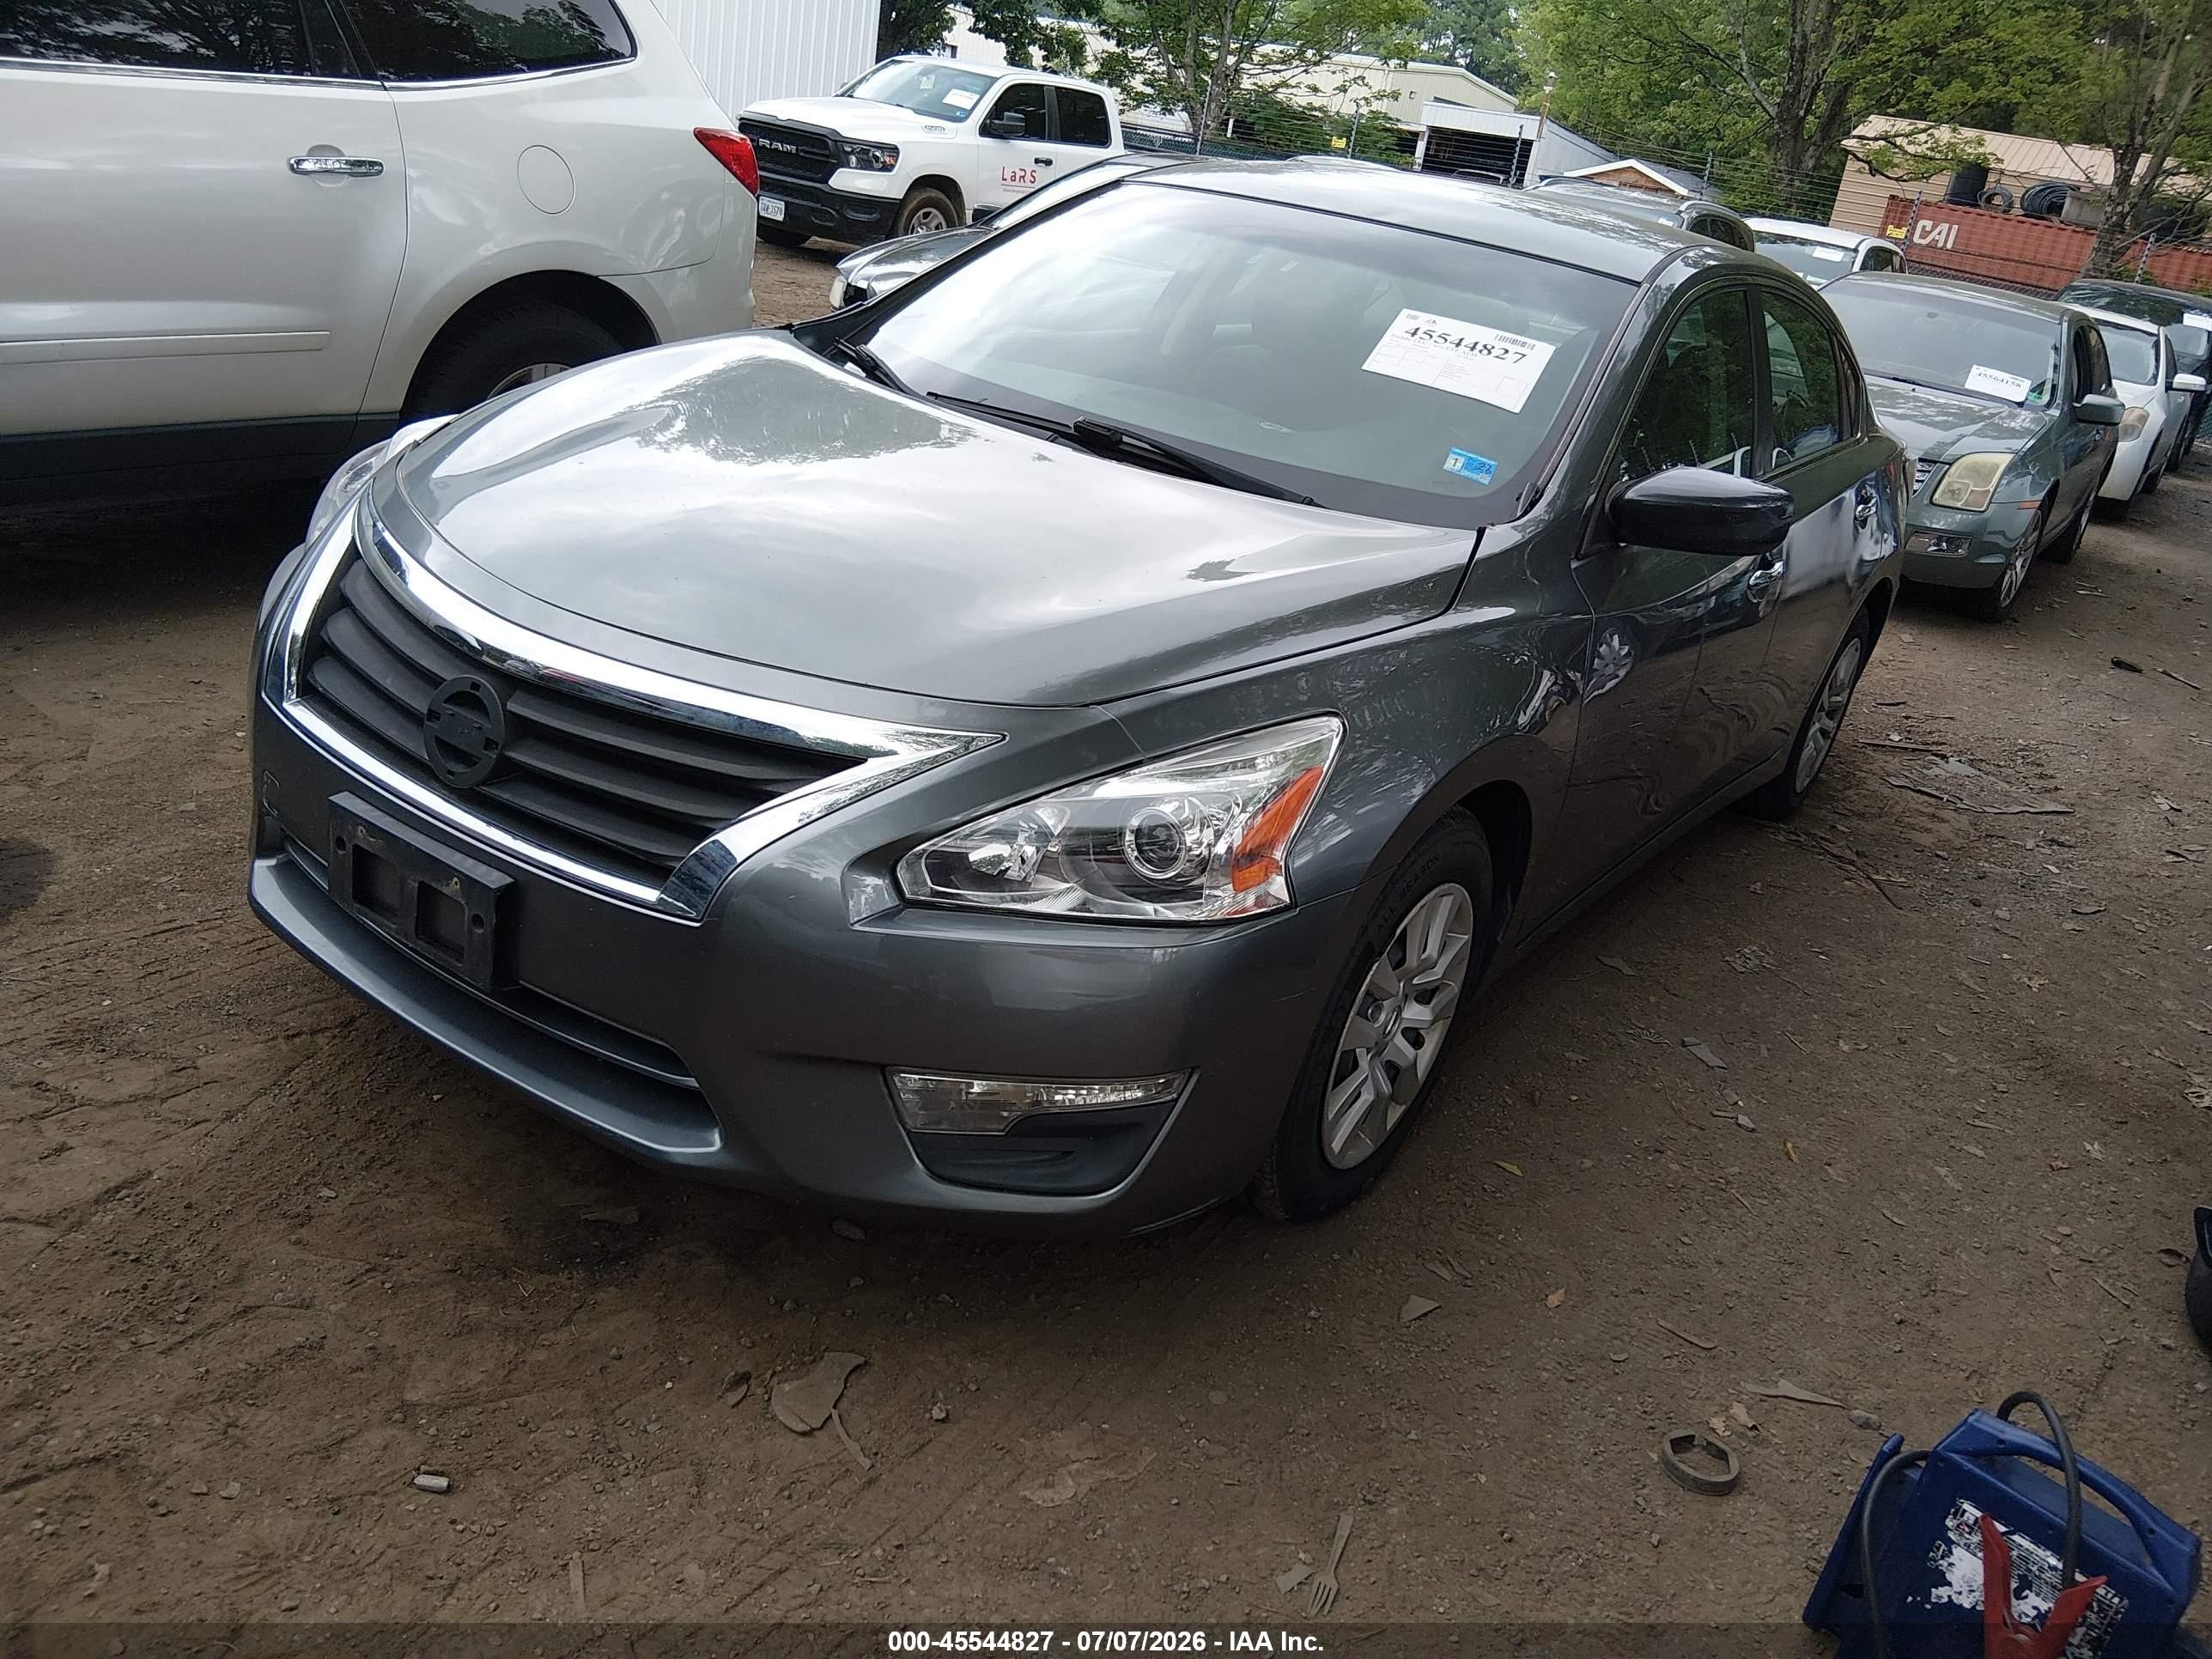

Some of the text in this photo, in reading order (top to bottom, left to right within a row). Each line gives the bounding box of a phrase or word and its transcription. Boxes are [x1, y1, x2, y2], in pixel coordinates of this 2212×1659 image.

[758, 138, 797, 153] RAM
[1001, 166, 1037, 184] LaRS
[1913, 220, 1958, 250] CAI
[1404, 326, 1528, 364] 45544827
